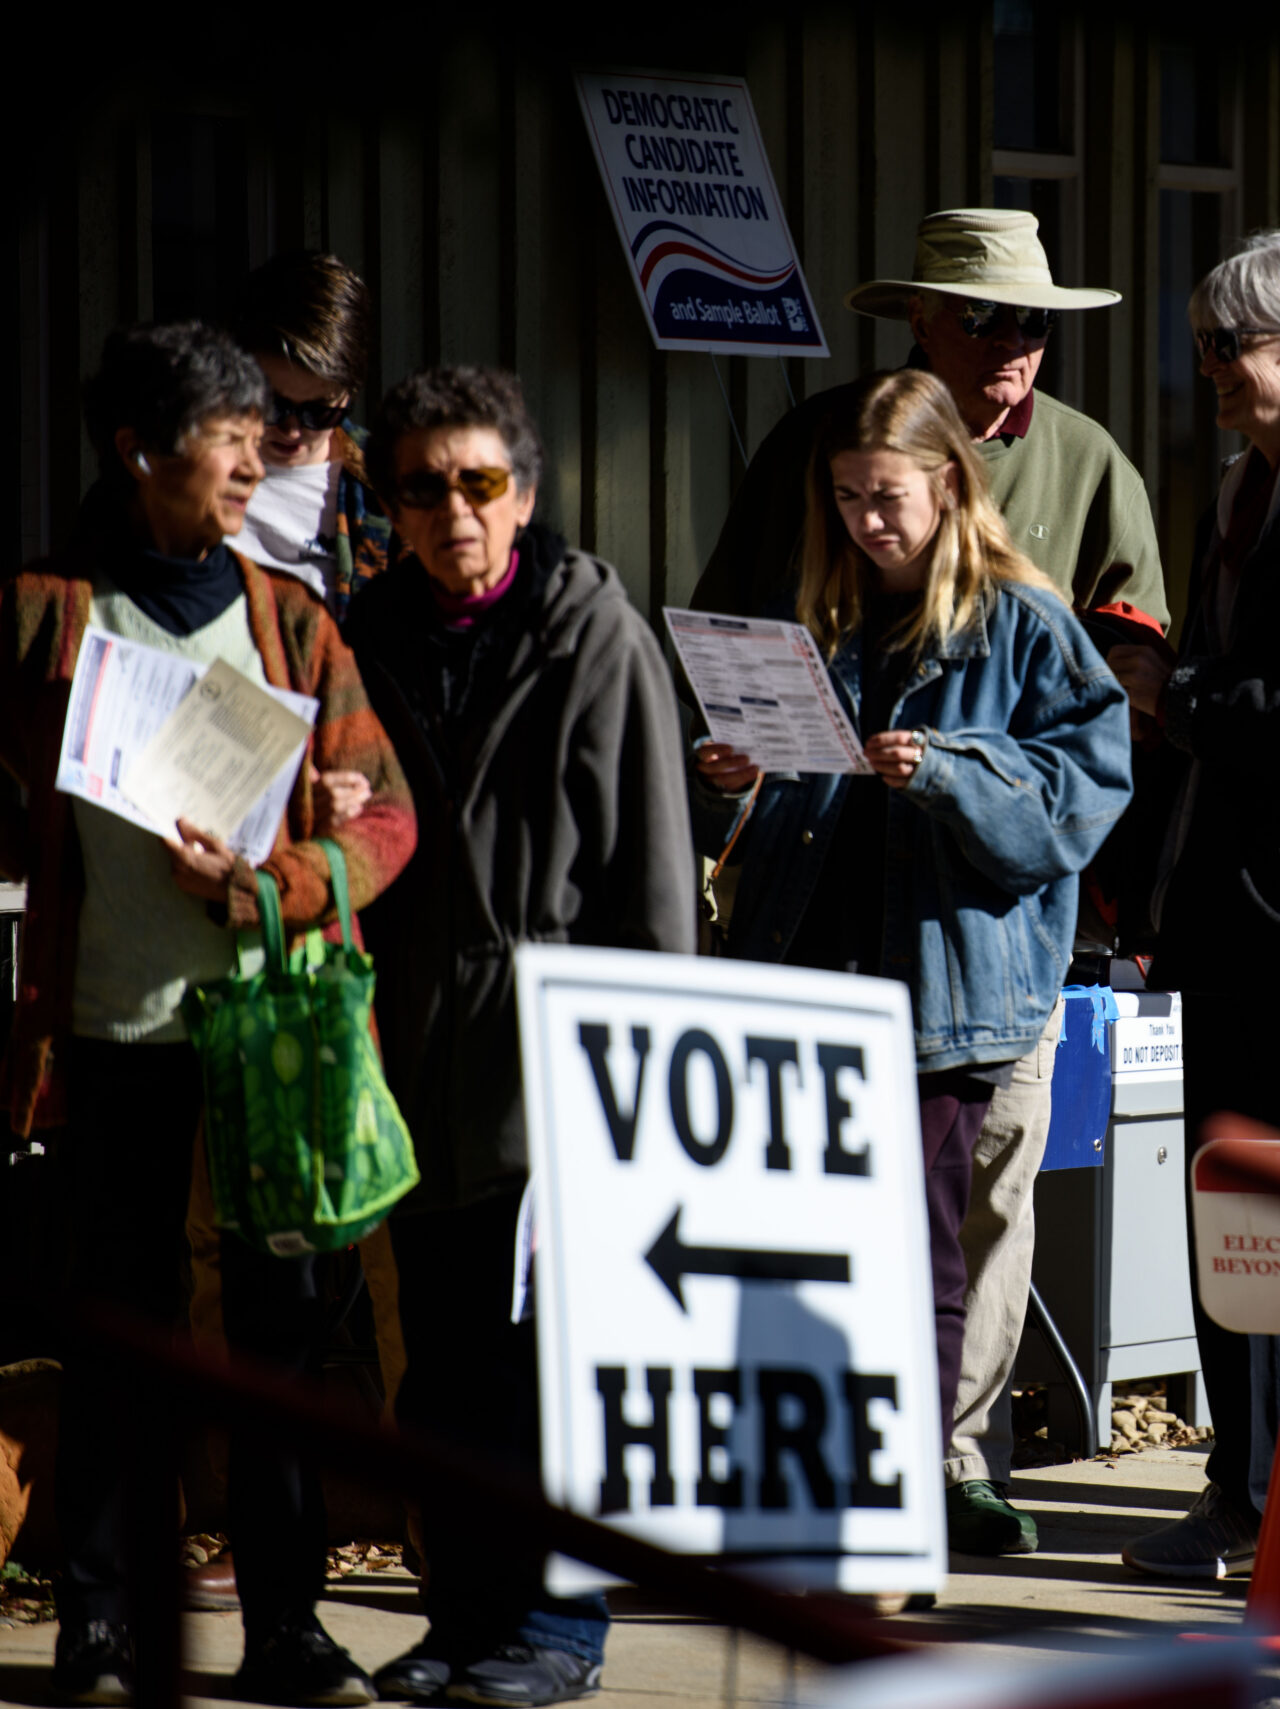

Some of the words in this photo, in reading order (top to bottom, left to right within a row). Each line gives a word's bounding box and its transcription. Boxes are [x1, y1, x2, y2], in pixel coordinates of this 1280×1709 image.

[601, 88, 740, 135] DEMOCRATIC
[625, 134, 744, 177] CANDIDATE
[622, 176, 769, 221] INFORMATION
[669, 296, 697, 320] and
[695, 297, 744, 329] Sample
[742, 300, 782, 326] Ballot
[1124, 1048, 1133, 1064] DO
[1135, 1046, 1149, 1063] NOT
[1151, 1044, 1179, 1062] DEPOSIT
[578, 1021, 873, 1178] VOTE
[595, 1363, 907, 1511] HERE
